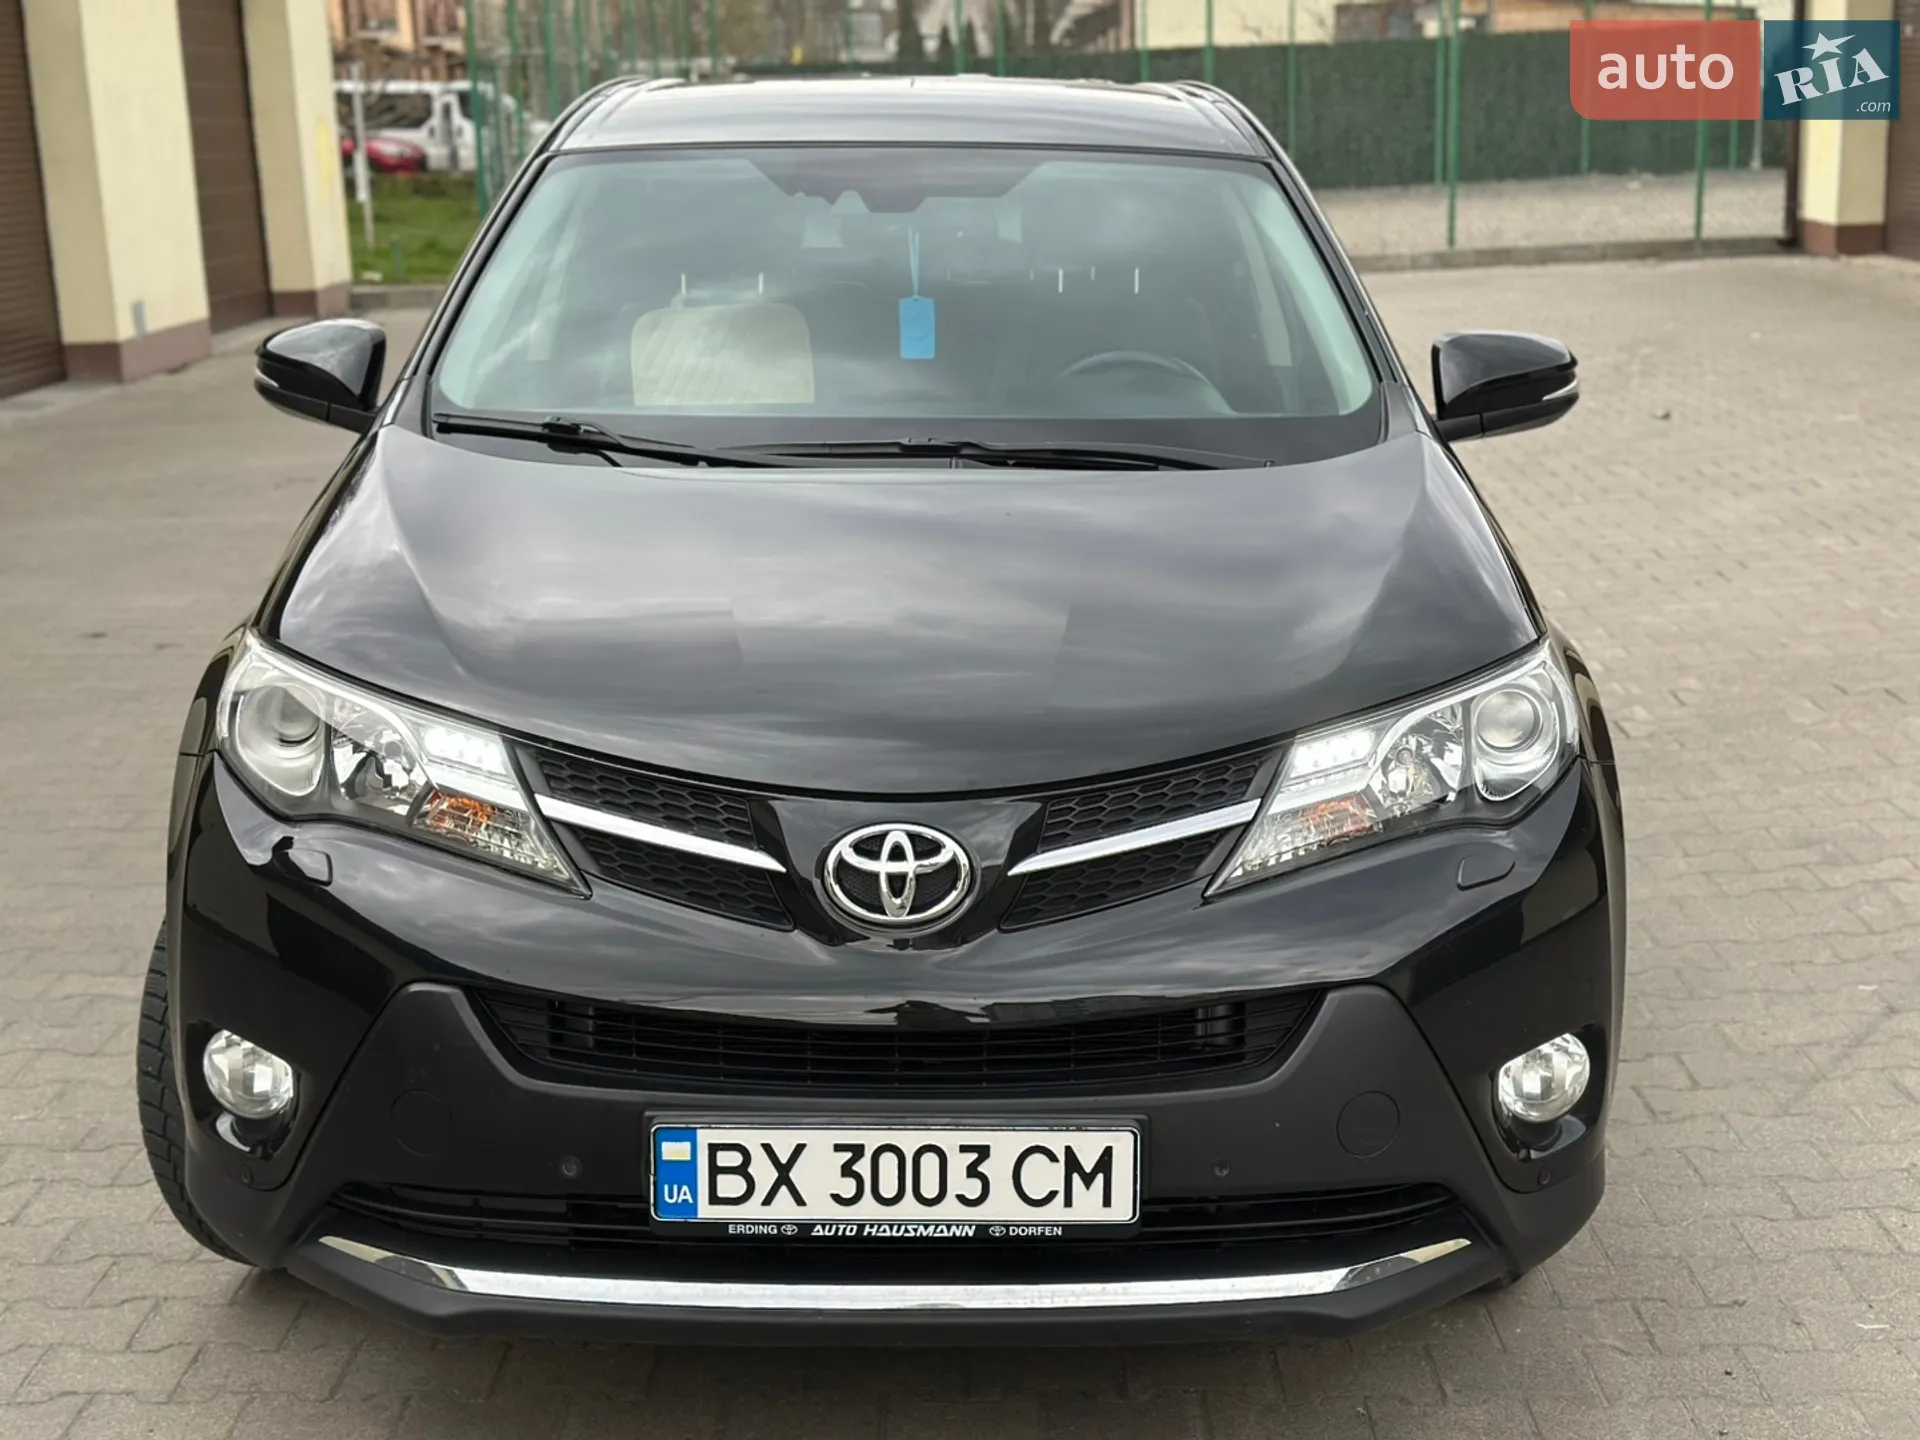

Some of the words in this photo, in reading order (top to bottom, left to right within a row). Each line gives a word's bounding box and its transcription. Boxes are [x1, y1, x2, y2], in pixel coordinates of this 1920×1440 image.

[707, 1142, 808, 1208] BX
[829, 1143, 991, 1208] 3003
[1012, 1144, 1114, 1209] CM
[663, 1184, 694, 1204] UA
[727, 1223, 778, 1236] ERDING
[810, 1225, 857, 1237] AUTO
[862, 1225, 976, 1238] HAUSMANN
[1008, 1225, 1063, 1237] DORFEN
